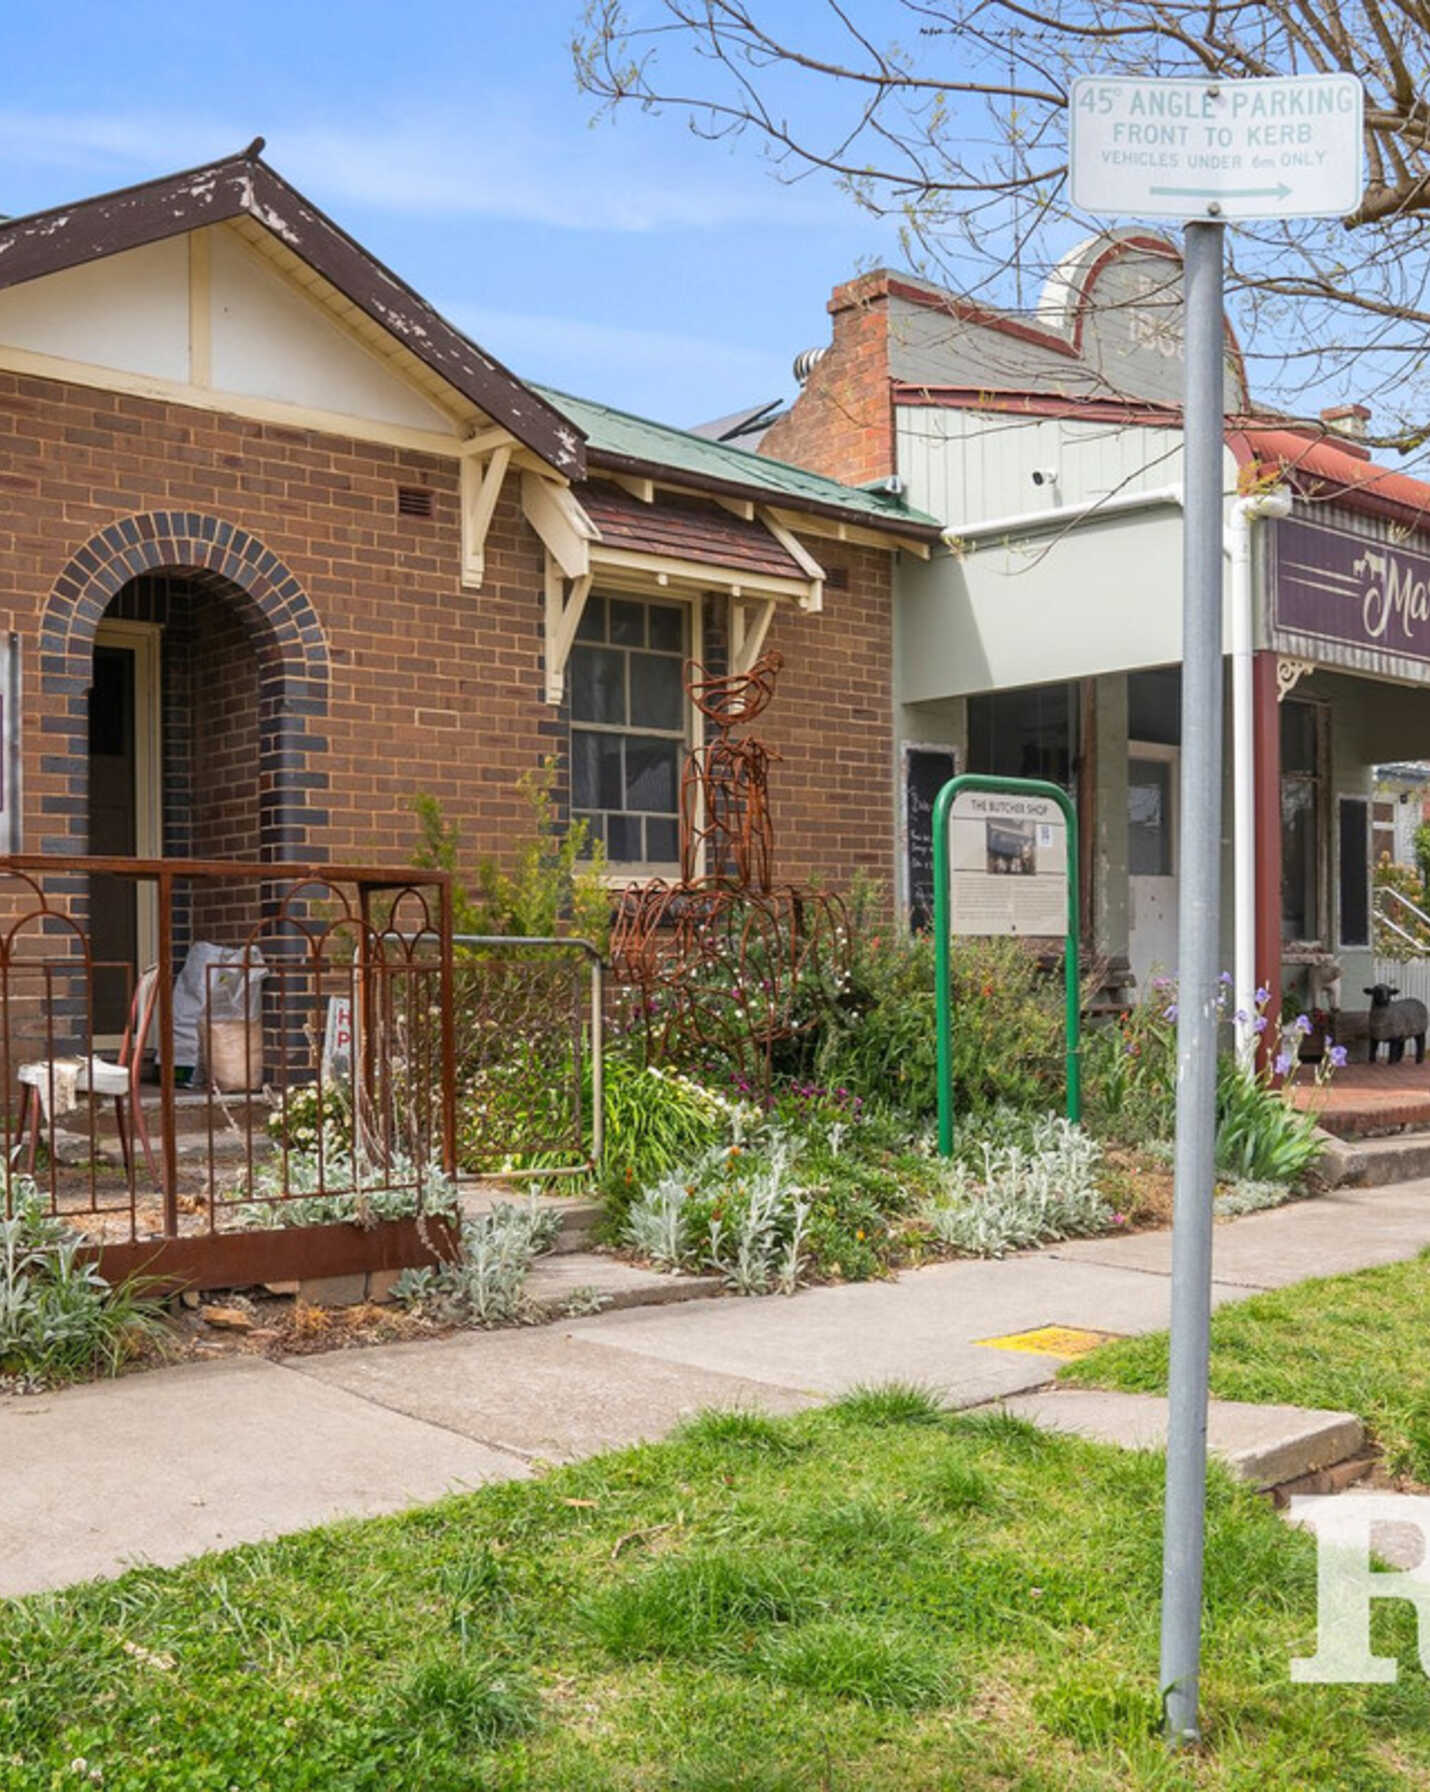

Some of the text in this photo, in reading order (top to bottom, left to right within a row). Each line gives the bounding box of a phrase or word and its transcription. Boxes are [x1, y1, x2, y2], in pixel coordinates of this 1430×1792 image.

[1129, 89, 1218, 119] ANGLE
[1232, 86, 1353, 118] PARKING
[1113, 123, 1313, 147] FRONT TO KERB
[1101, 150, 1328, 169] VEHICLES UNDER 6m ONLY
[1363, 557, 1430, 637] Ma
[972, 799, 1048, 816] THE BUTCHER SHOP
